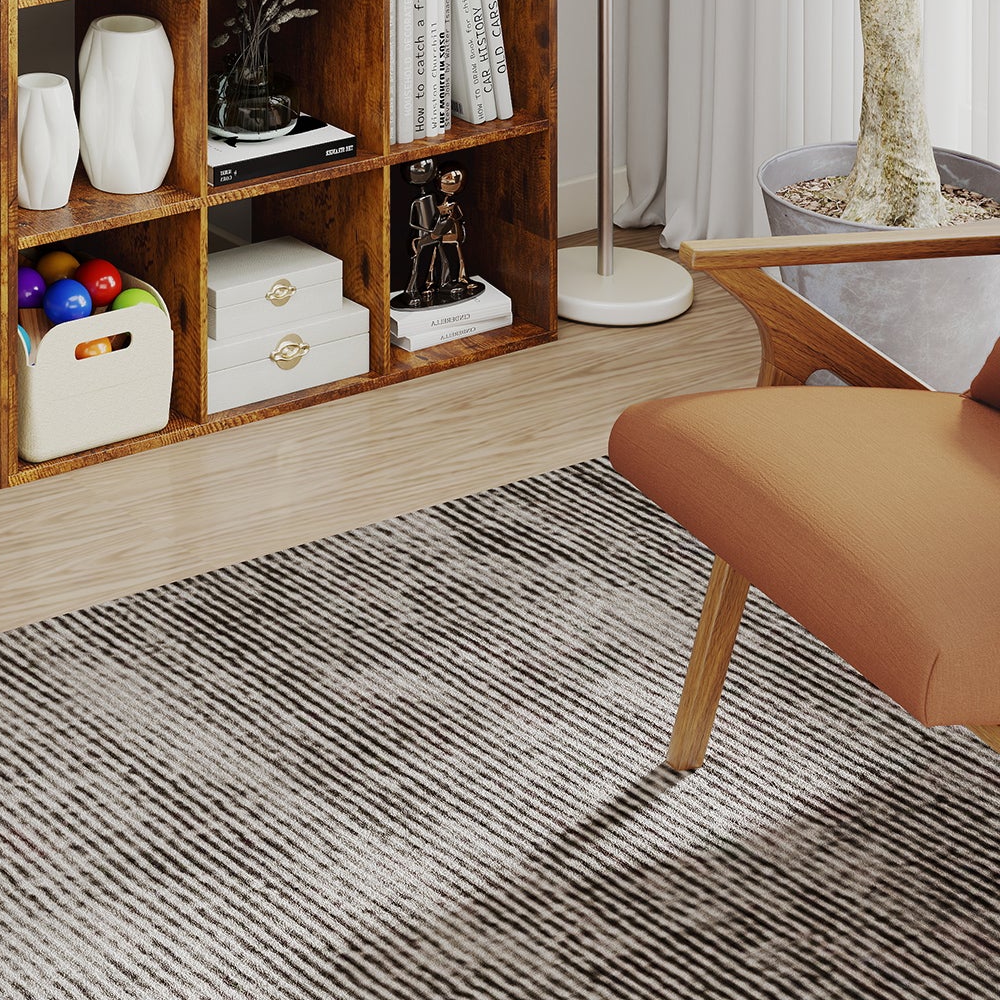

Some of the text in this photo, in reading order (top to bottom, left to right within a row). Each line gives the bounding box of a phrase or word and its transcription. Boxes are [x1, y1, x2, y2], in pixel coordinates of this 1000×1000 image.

[417, 18, 425, 27] a
[488, 0, 506, 74] OLD CARS
[414, 35, 425, 76] catch
[473, 7, 492, 93] CAR HISTORY
[415, 83, 425, 100] to
[415, 106, 425, 132] How
